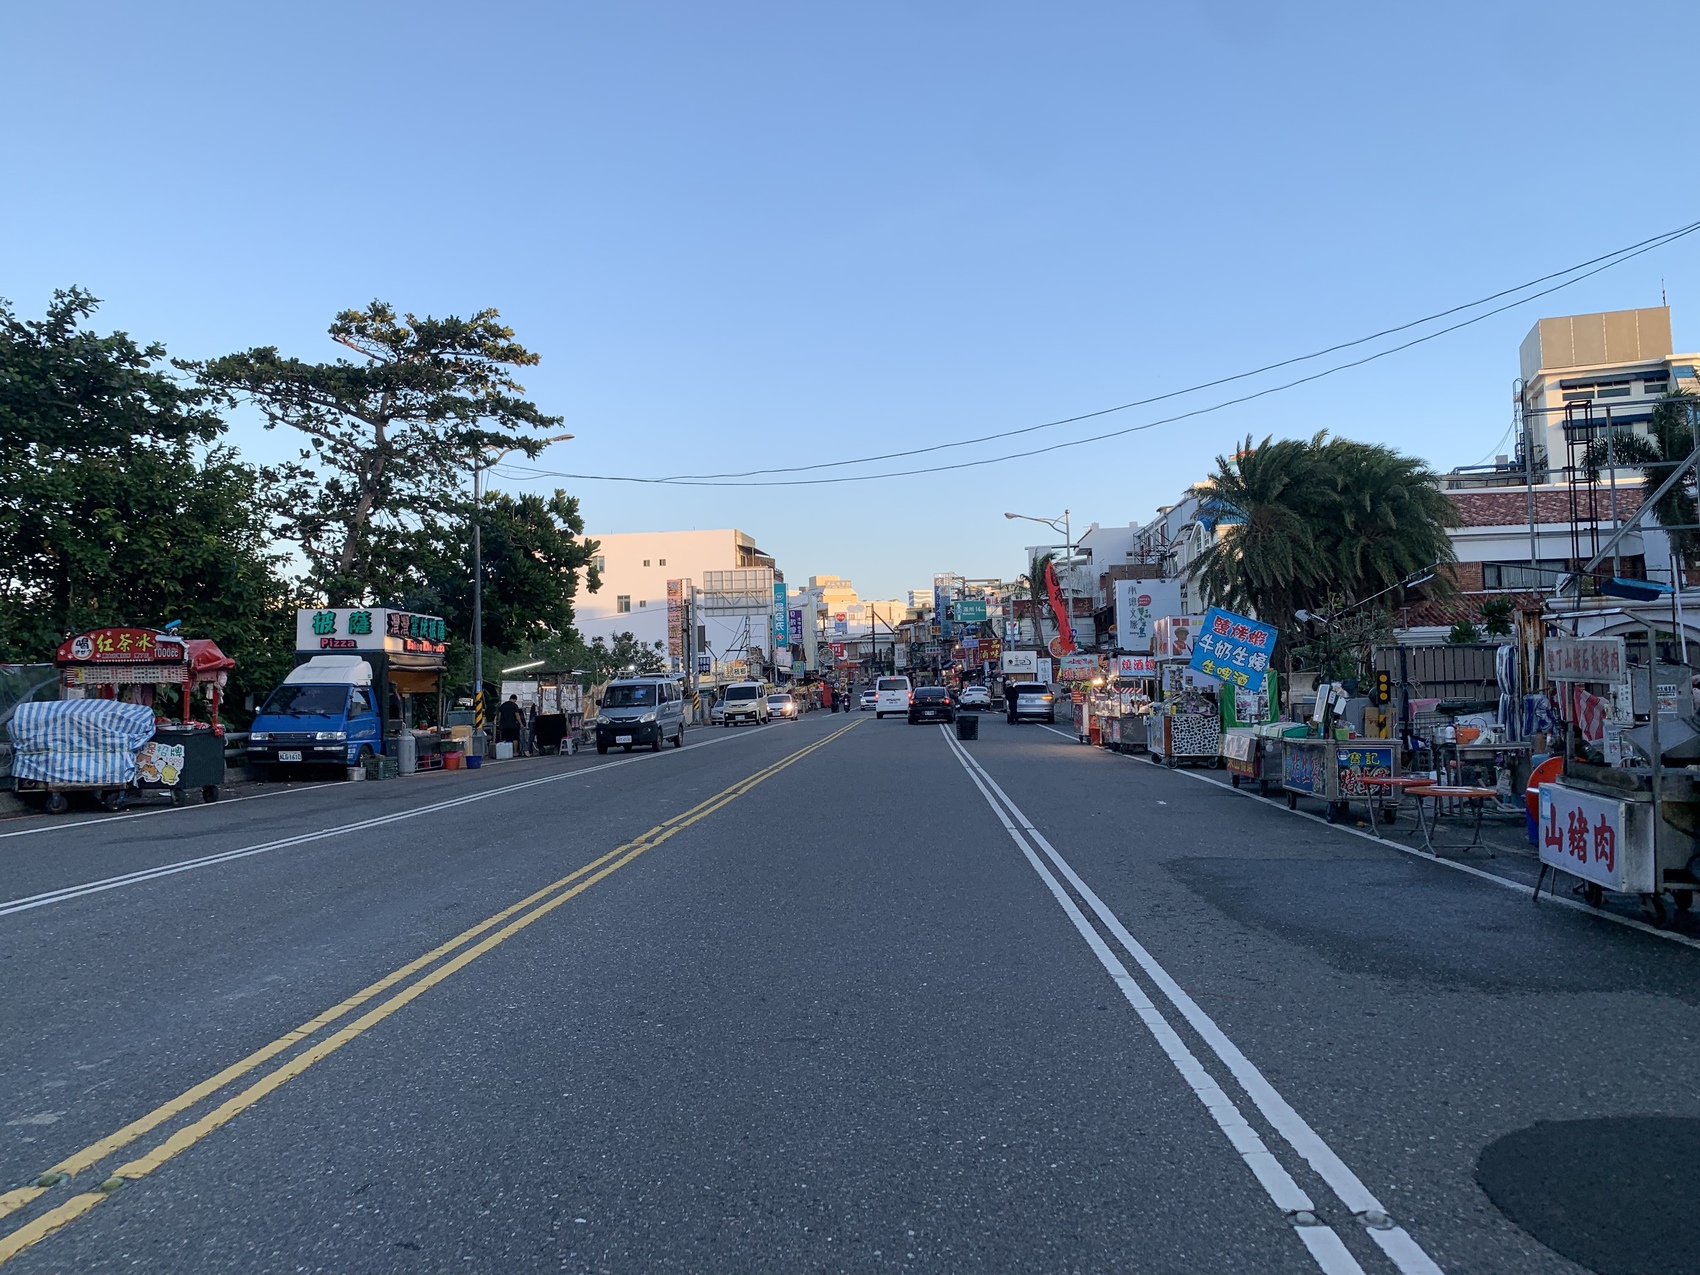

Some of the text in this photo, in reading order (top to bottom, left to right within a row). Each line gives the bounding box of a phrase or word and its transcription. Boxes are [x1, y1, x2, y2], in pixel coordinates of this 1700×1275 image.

[312, 611, 373, 635] 披薩
[1213, 615, 1269, 648] 鹽烤蝦
[96, 633, 154, 652] 紅茶冰
[320, 638, 356, 648] Pizza
[1199, 634, 1269, 672] 牛奶生蠔
[1202, 659, 1250, 687] 生啤酒
[1349, 752, 1381, 766] 寶記
[1545, 802, 1616, 873] 山豬肉
